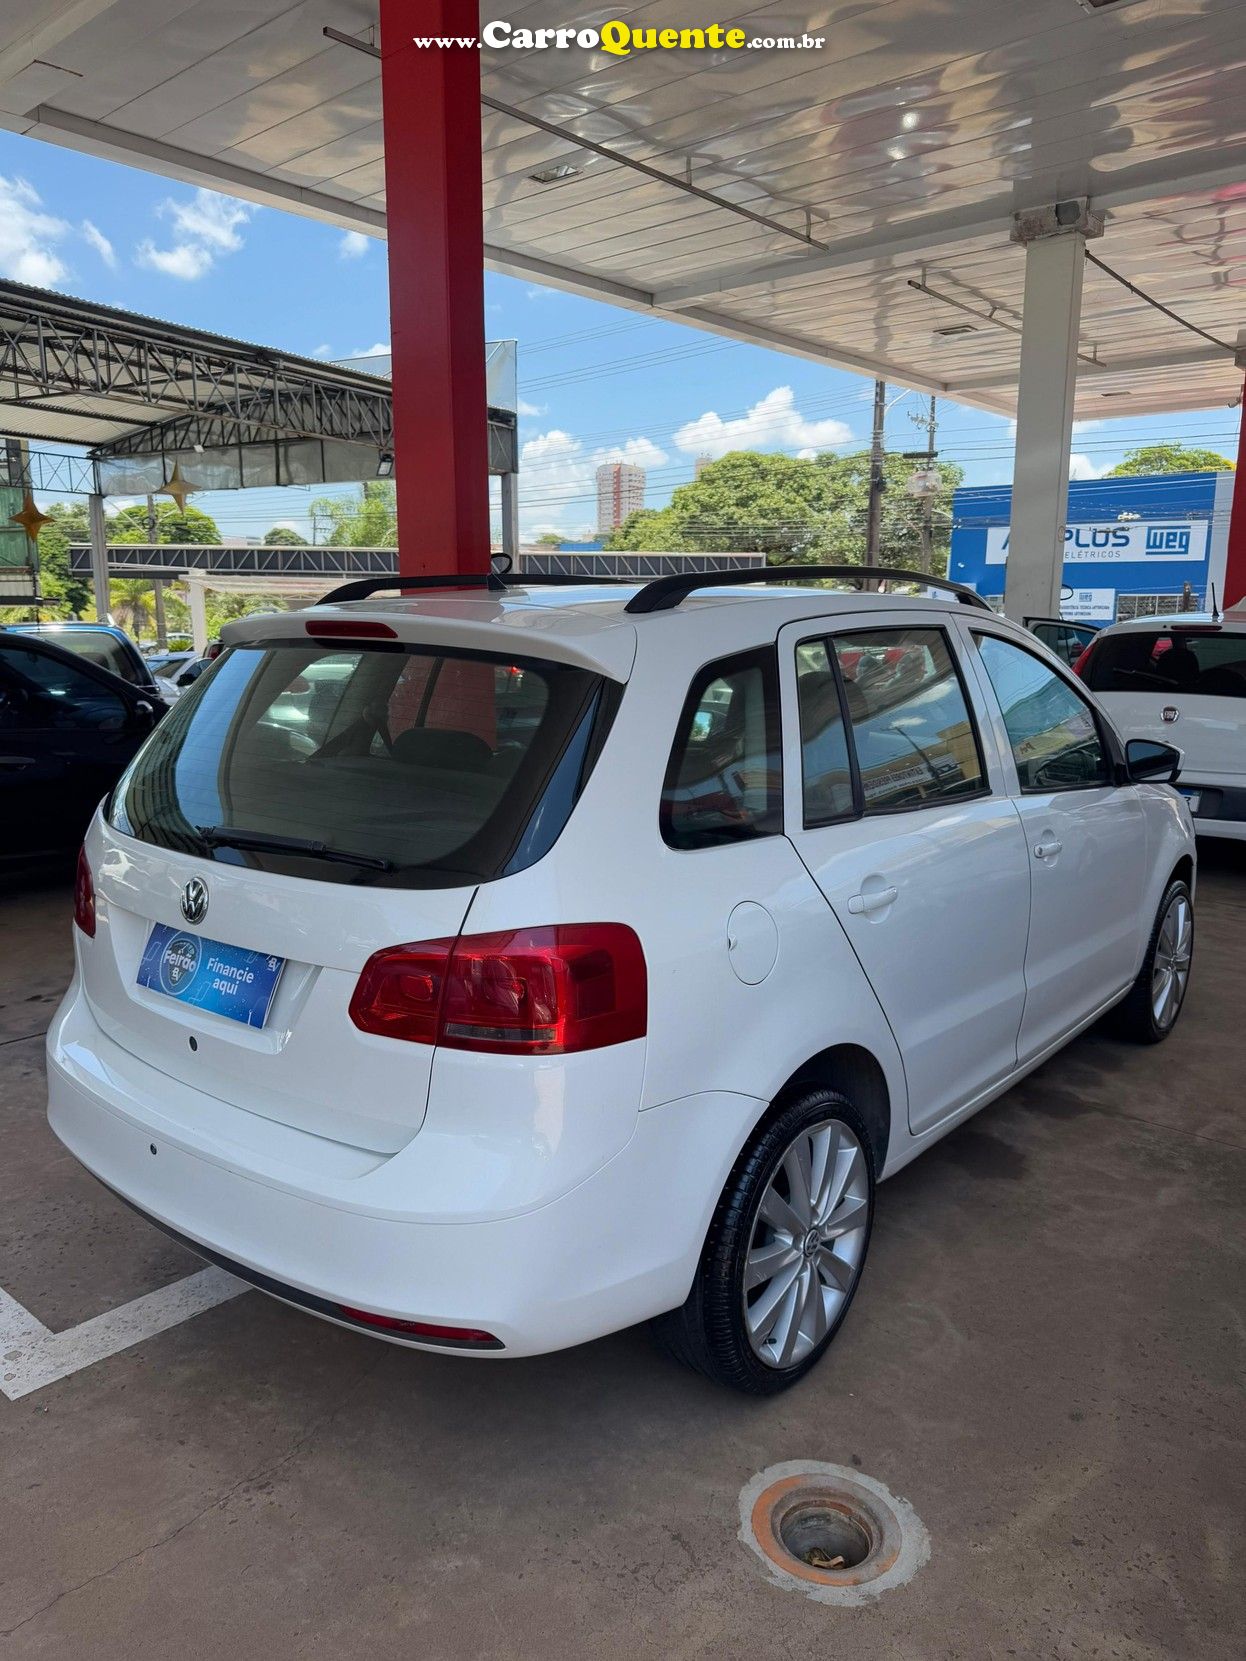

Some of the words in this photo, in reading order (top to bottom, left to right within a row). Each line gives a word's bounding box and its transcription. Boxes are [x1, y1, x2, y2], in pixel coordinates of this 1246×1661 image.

[1064, 550, 1121, 559] ELÉTRICOS
[163, 950, 197, 973] Feirão
[206, 957, 255, 984] Financie
[212, 978, 240, 996] aqui
